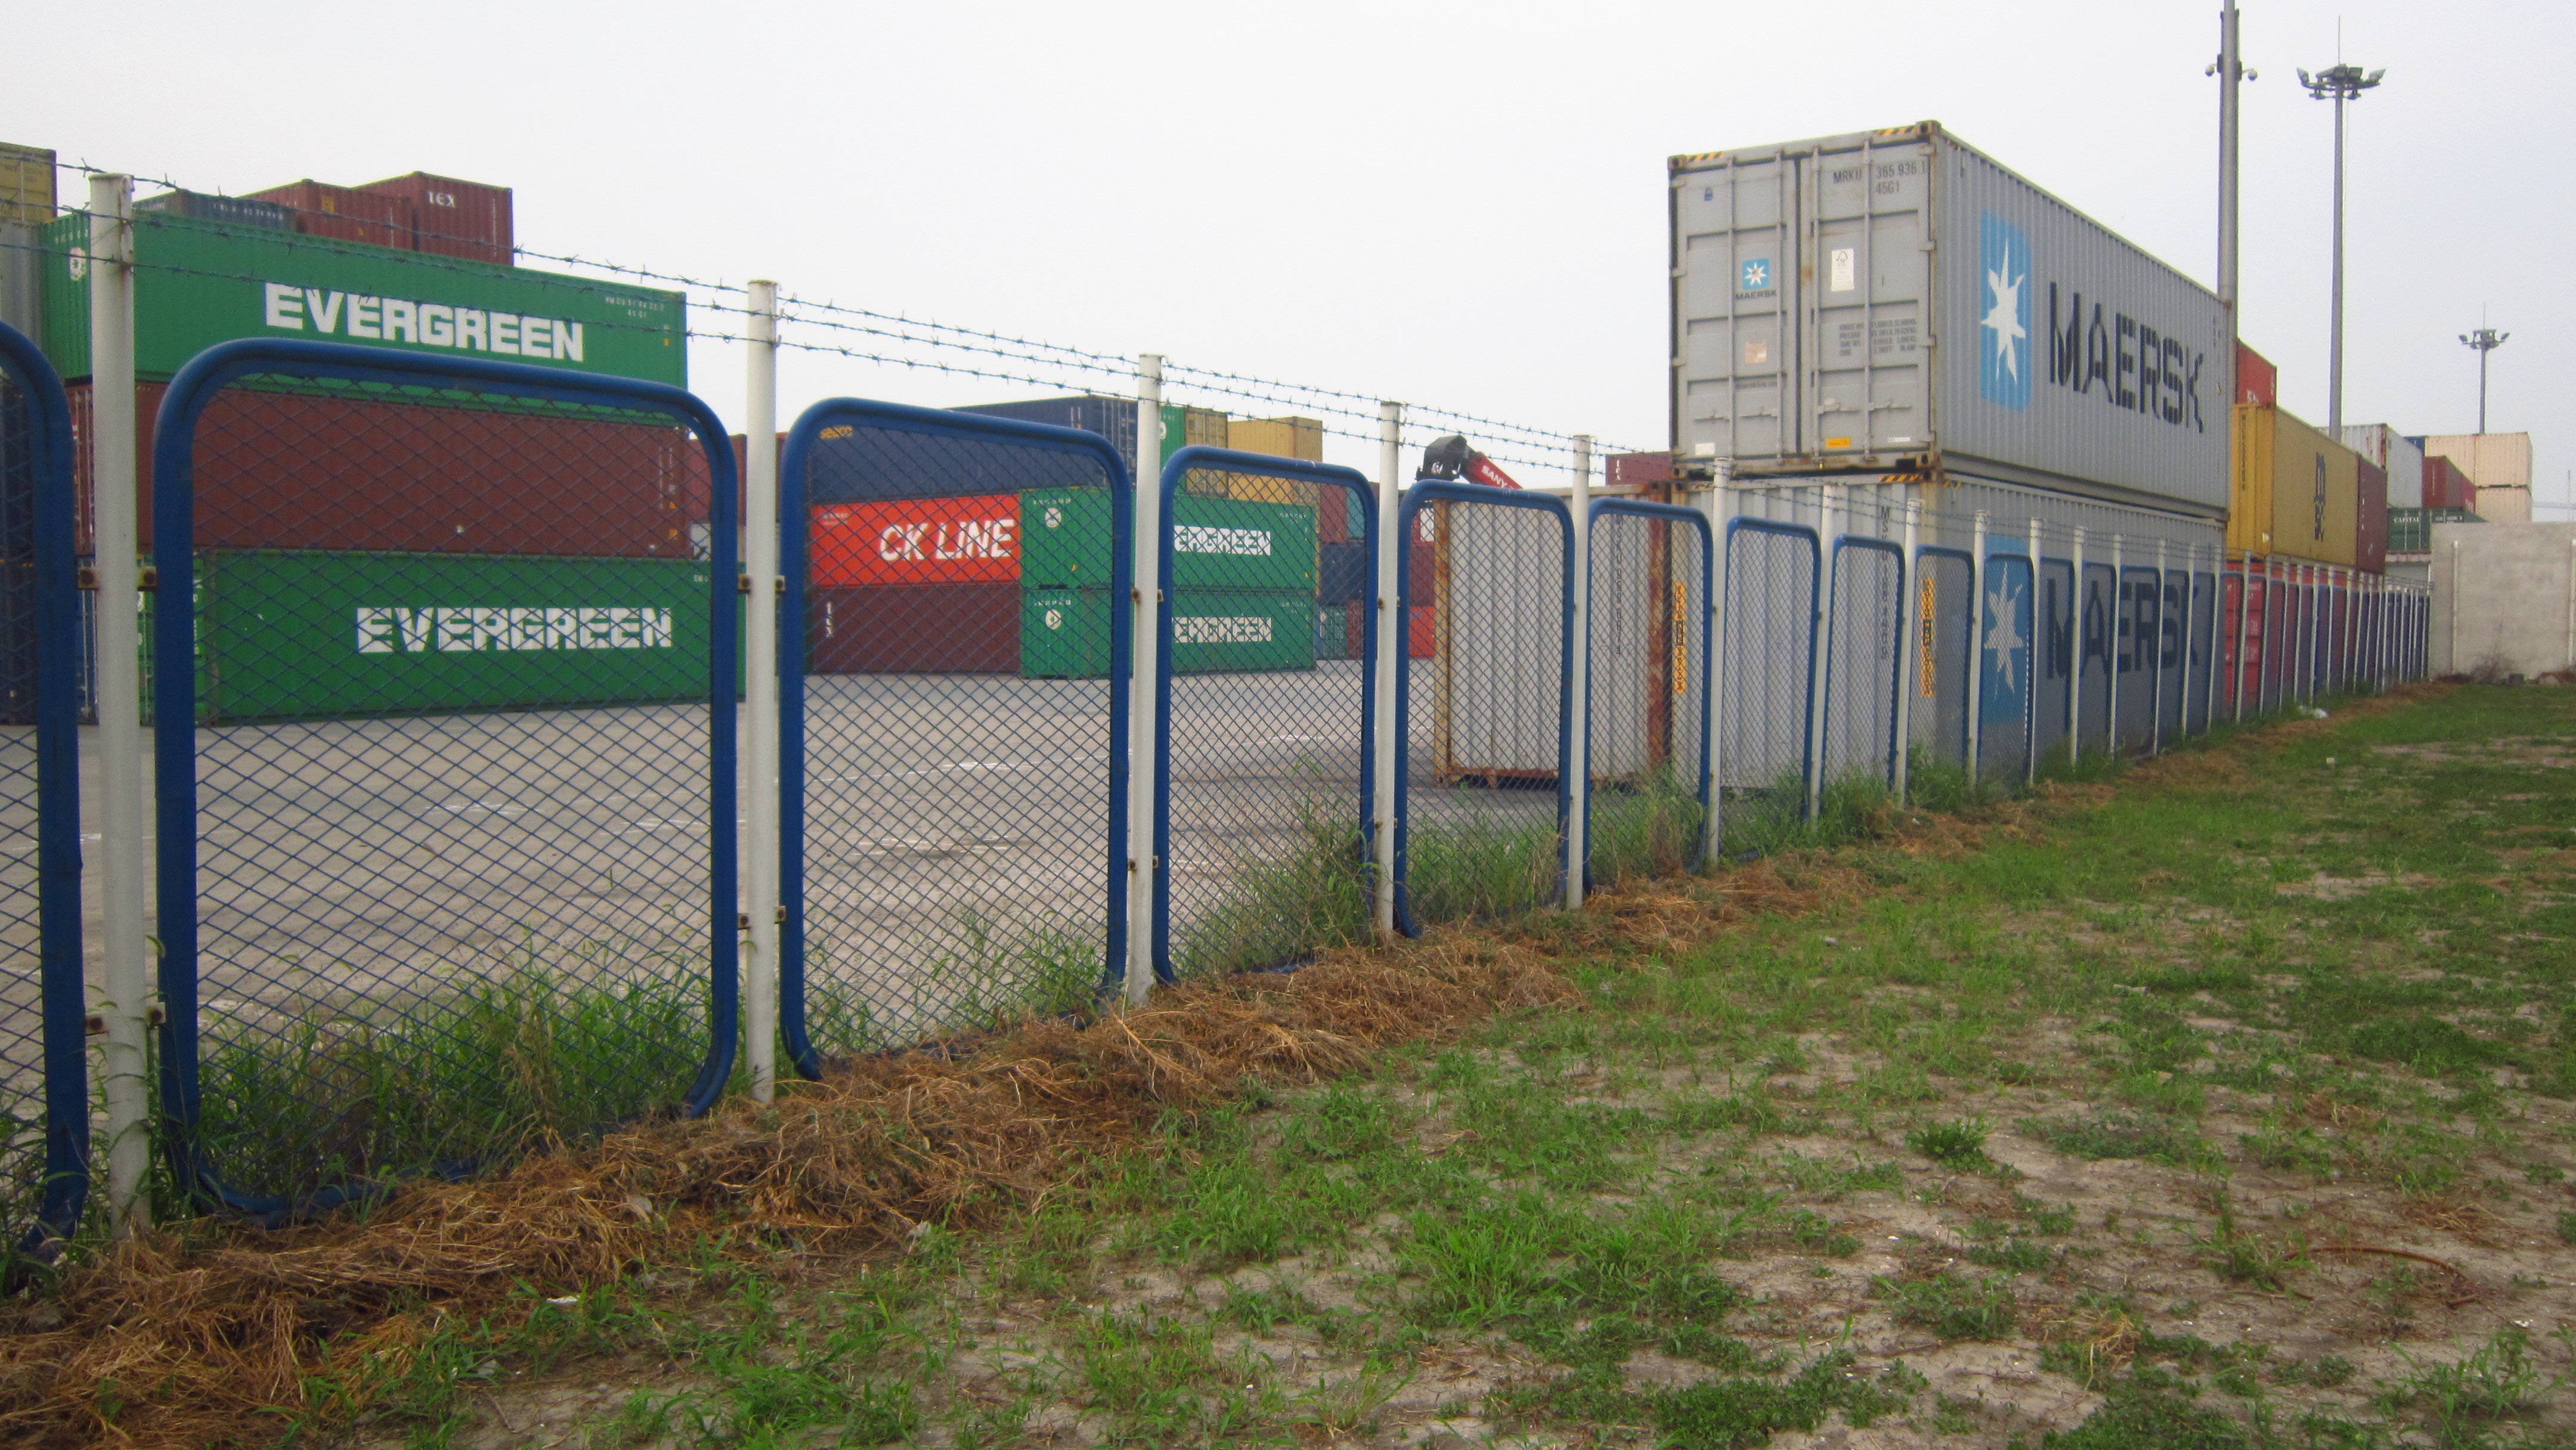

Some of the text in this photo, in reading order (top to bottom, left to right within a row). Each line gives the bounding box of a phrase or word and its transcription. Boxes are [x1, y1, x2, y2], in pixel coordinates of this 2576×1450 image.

[1833, 169, 1862, 184] MRKU
[1876, 164, 1895, 179] 365
[1898, 162, 1917, 176] 936
[1735, 289, 1777, 300] MAERSK
[265, 283, 584, 362] EVERGREEN
[2049, 281, 2204, 434] MAERSK
[1481, 465, 1507, 488] SANY
[880, 519, 1015, 562] CK LINE
[1174, 525, 1271, 556] ERGREEN
[357, 607, 673, 653] EVERGREEN
[1172, 616, 1272, 643] ERGREEN
